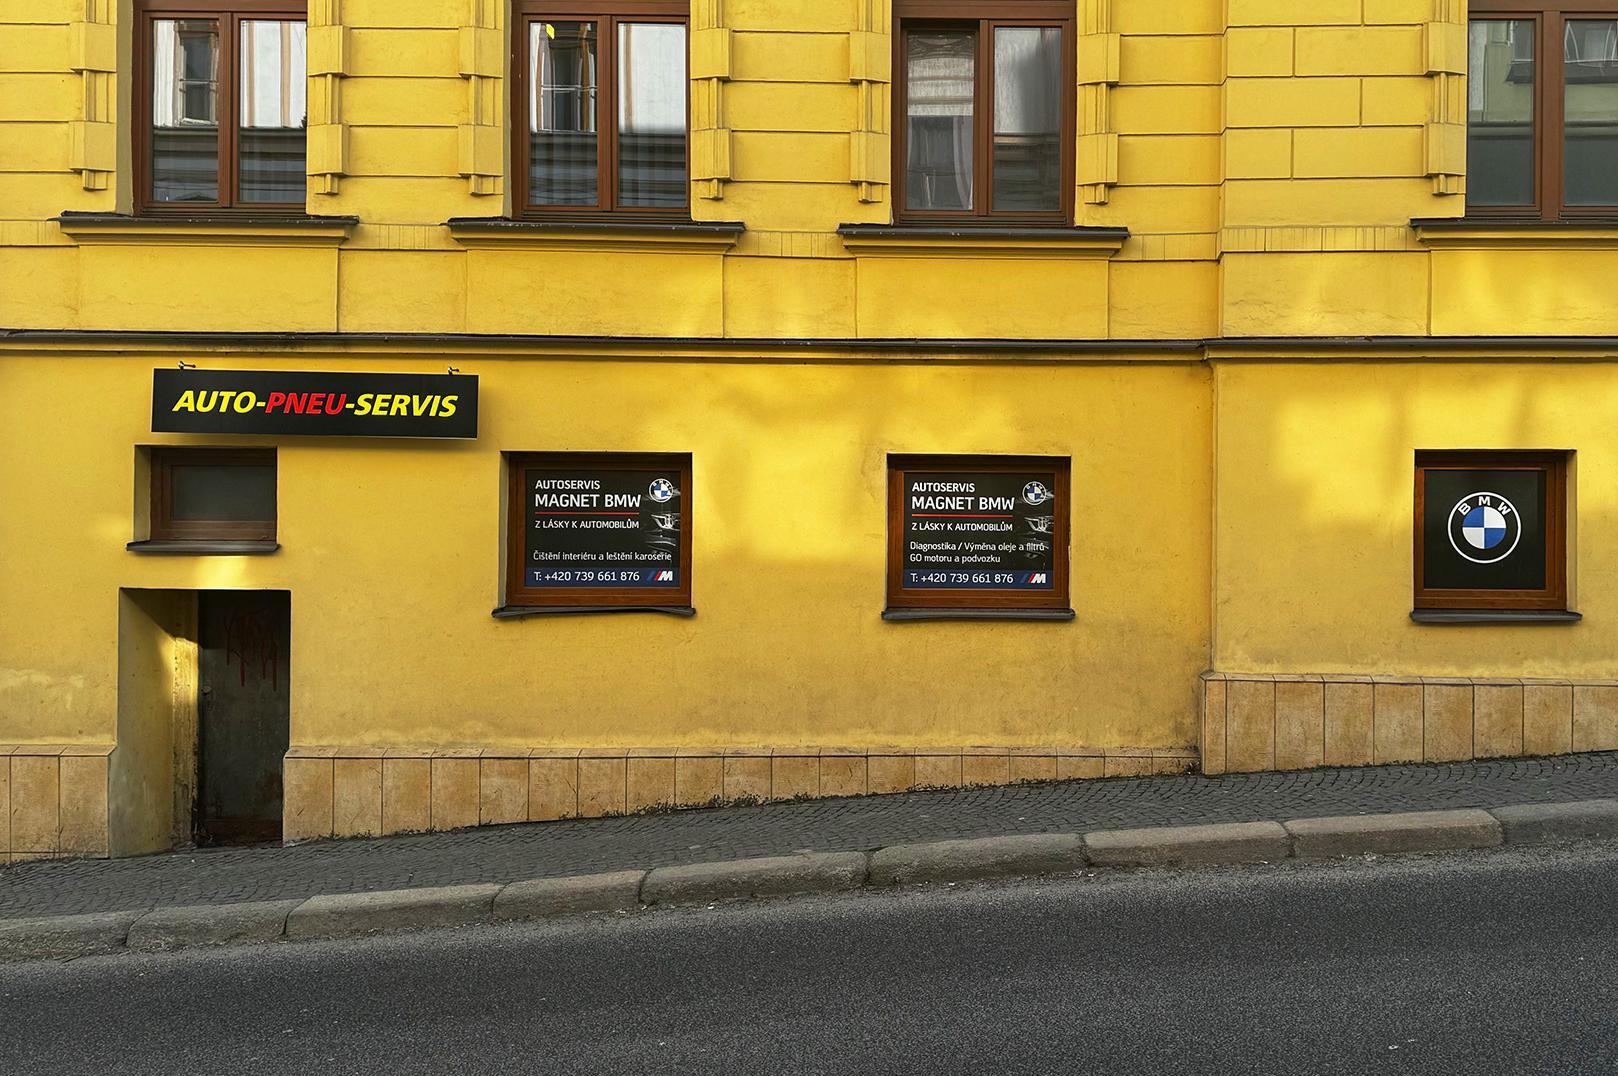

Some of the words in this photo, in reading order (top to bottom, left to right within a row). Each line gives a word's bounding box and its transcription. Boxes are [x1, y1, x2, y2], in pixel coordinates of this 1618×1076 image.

[172, 390, 459, 418] AUTO-PNEU-SERVIS
[535, 480, 601, 490] AUTOSERVIS
[911, 482, 975, 492] AUTOSERVIS
[535, 494, 600, 508] MAGNET
[604, 494, 641, 508] BMW
[911, 496, 975, 510] MAGNET
[979, 497, 1015, 511] BMW
[1457, 496, 1512, 516] BMW
[535, 520, 541, 529] Z
[543, 519, 571, 529] LÁSKY
[572, 520, 578, 529] K
[580, 519, 640, 529] AUTOMOBILŮM
[911, 523, 917, 531] Z
[919, 521, 945, 531] LÁSKY
[947, 523, 953, 531] K
[955, 521, 1013, 531] AUTOMOBILŮM
[910, 541, 956, 552] Diagnostika
[964, 541, 996, 553] Výměna
[998, 542, 1017, 553] oleje
[533, 550, 561, 561] Čištění
[562, 551, 597, 561] interiéru
[598, 553, 604, 561] a
[606, 550, 633, 561] leštění
[910, 554, 922, 562] GO
[924, 555, 952, 563] motoru
[961, 554, 1001, 565] podvozku
[534, 571, 542, 581] T:
[544, 571, 571, 581] +420
[574, 571, 595, 581] 739
[597, 571, 617, 581] 661
[620, 571, 640, 581] 876
[910, 573, 918, 583] T:
[920, 573, 947, 583] +420
[950, 573, 970, 583] 739
[972, 573, 991, 583] 661
[994, 573, 1014, 583] 876
